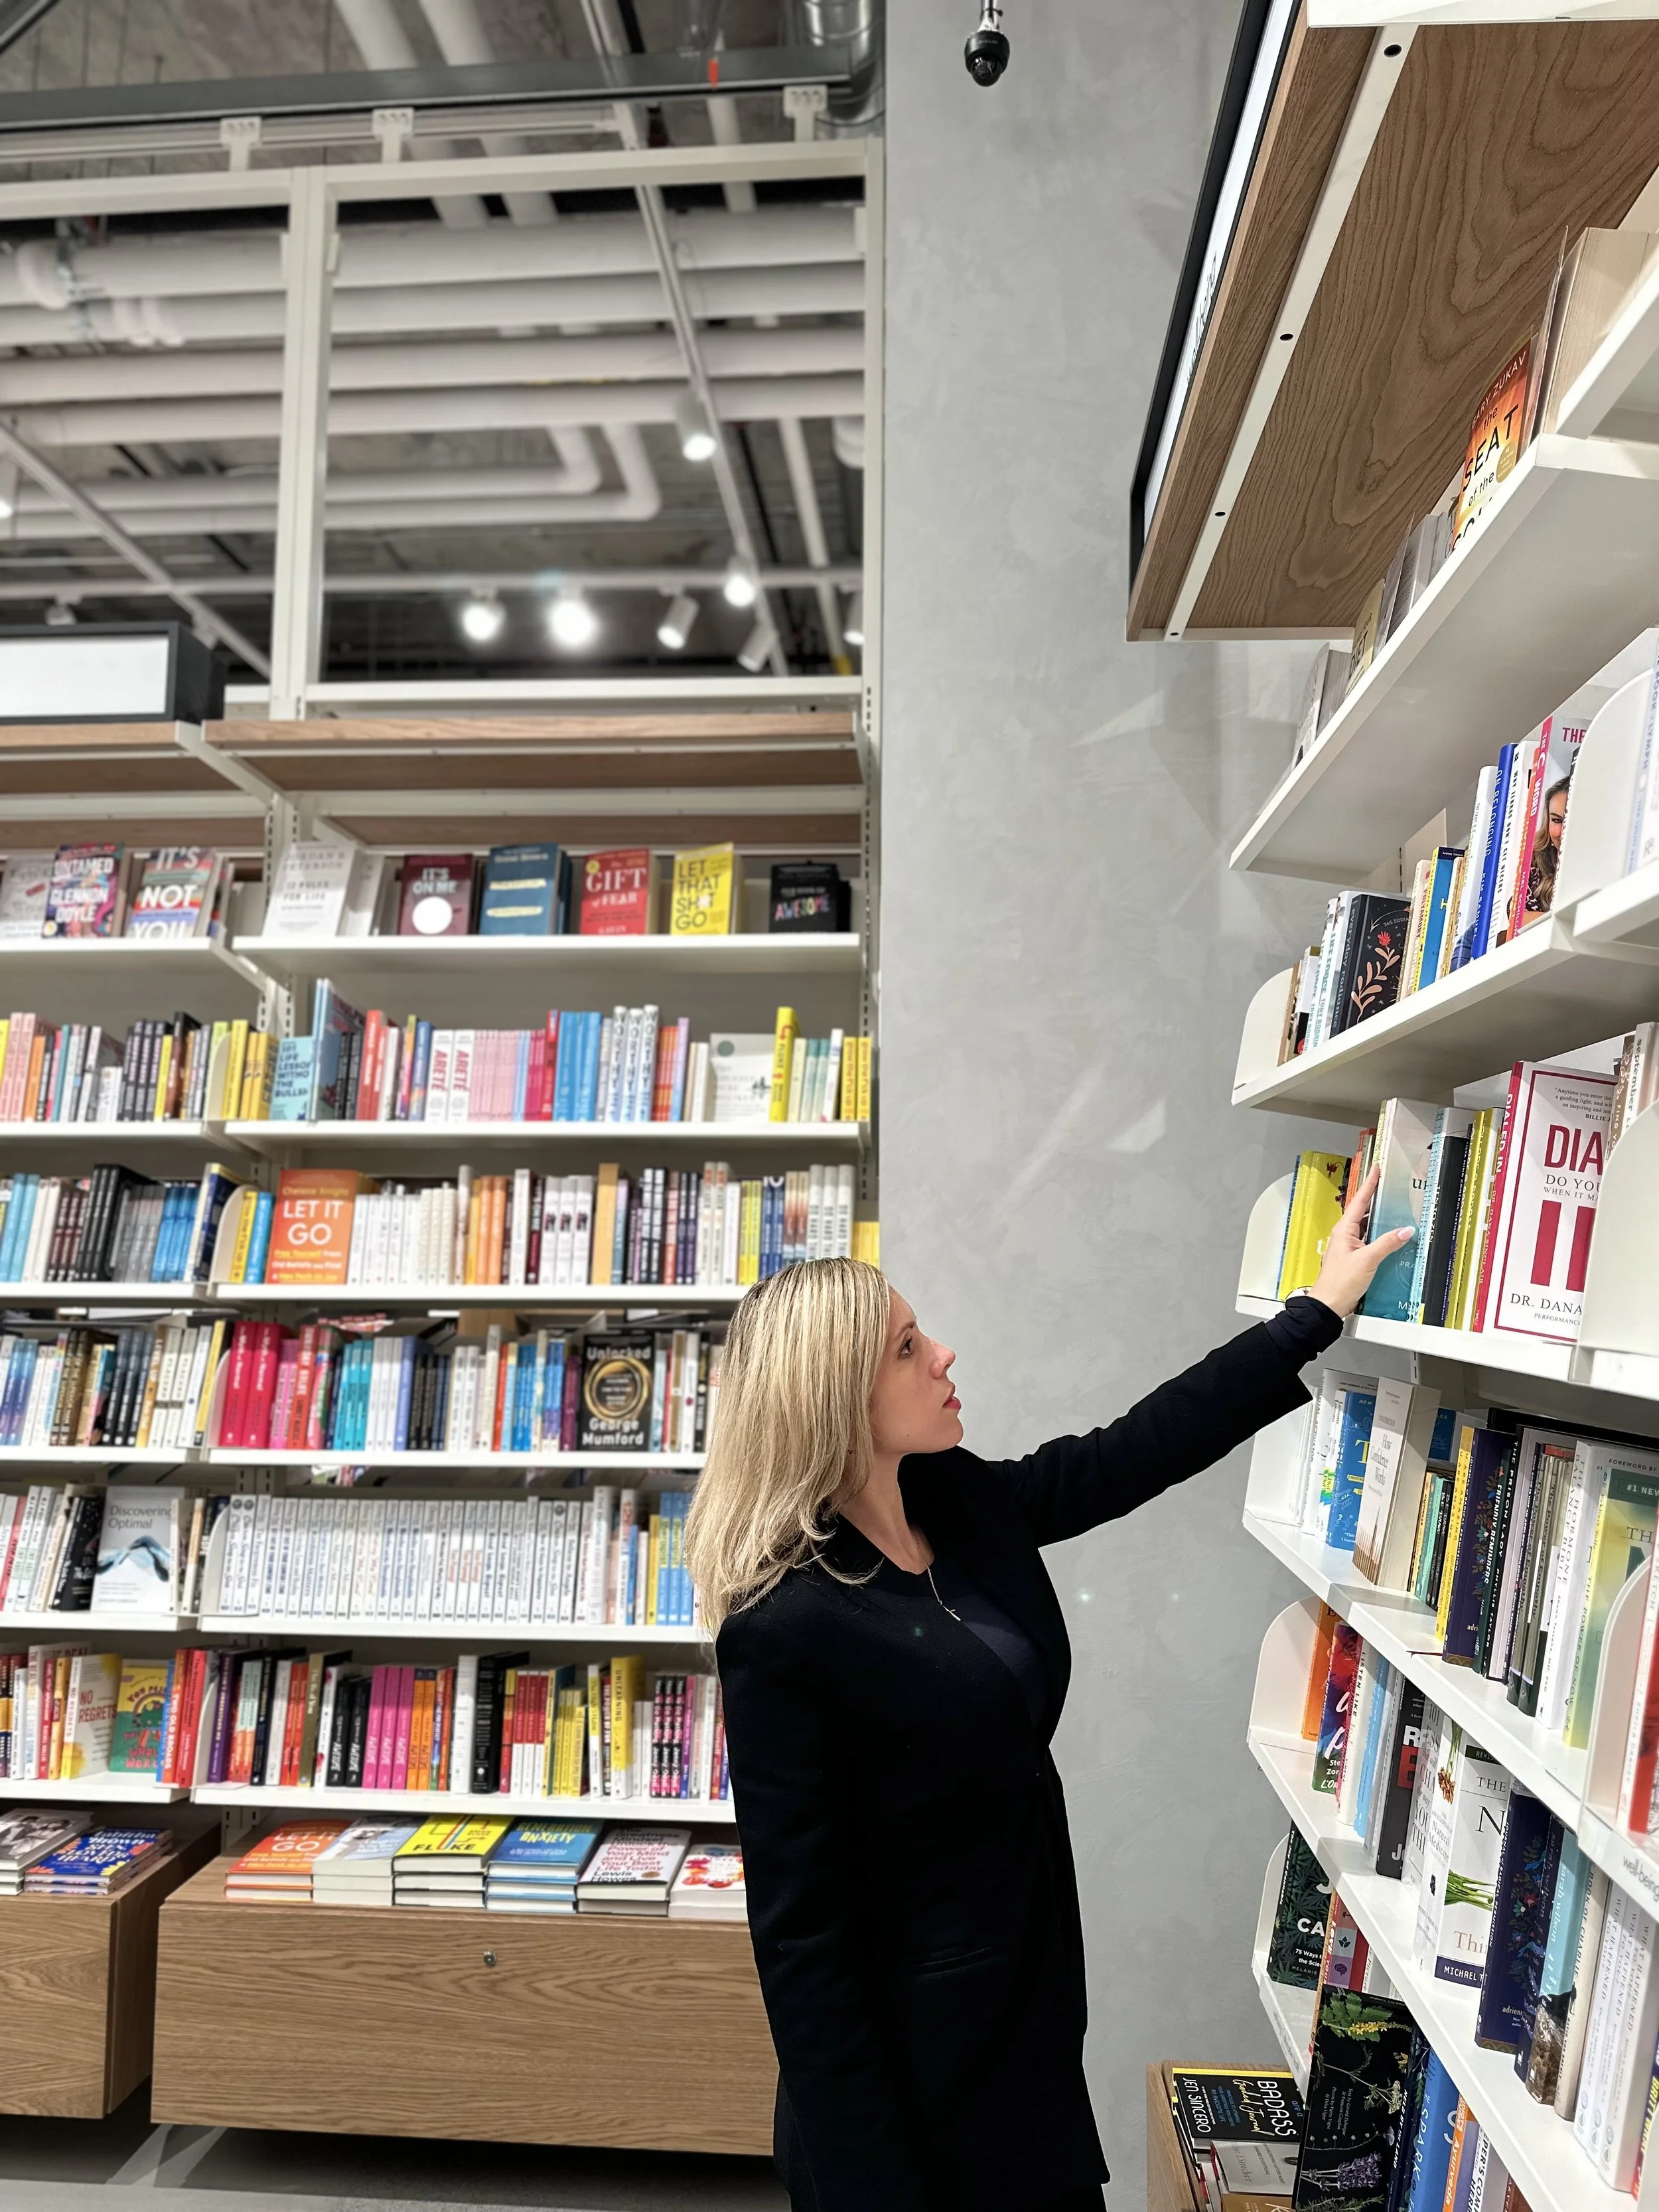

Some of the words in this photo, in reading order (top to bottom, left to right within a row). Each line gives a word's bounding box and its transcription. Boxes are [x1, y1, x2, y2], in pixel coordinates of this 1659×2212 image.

[1471, 397, 1492, 430] GARY
[1492, 351, 1526, 398] ZUKAV
[1483, 407, 1498, 430] the
[1462, 404, 1519, 493] SEAT
[1469, 488, 1479, 507] of
[1479, 471, 1494, 494] the
[1540, 731, 1548, 752] THE
[1562, 727, 1585, 744] THE
[1642, 723, 1653, 770] LYMPH
[1507, 791, 1516, 820] ZEBRAS
[1530, 777, 1543, 817] WORD
[1503, 822, 1512, 844] DON'T
[155, 847, 200, 870] IT'S
[678, 859, 707, 878] LET
[413, 881, 433, 895] ON
[435, 881, 459, 894] ME
[423, 867, 450, 881] IT'S
[585, 867, 646, 893] GIFT
[677, 873, 721, 895] THAT
[1496, 865, 1506, 894] ULCERS
[141, 885, 198, 908] NOT
[601, 892, 638, 907] FEAR
[774, 894, 830, 921] AWESOME
[675, 911, 707, 930] GO
[1473, 896, 1484, 939] SAMUEL
[1342, 907, 1356, 968] everyday
[1333, 970, 1346, 1030] radiance
[276, 1080, 293, 1088] THE
[1628, 1039, 1642, 1112] september
[1500, 1092, 1513, 1152] DIALED
[1569, 1102, 1591, 1112] inspiring
[1496, 1155, 1504, 1173] IN
[1455, 1179, 1464, 1211] CONTROL
[1544, 1187, 1571, 1197] WHEN
[1546, 1175, 1568, 1187] DO
[283, 1200, 319, 1218] LET
[324, 1200, 344, 1218] IT
[1485, 1209, 1495, 1236] DANA
[287, 1222, 332, 1245] GO
[1479, 1238, 1490, 1284] SINCLAIR
[1510, 1293, 1535, 1307] DR.
[1540, 1297, 1583, 1315] DANA
[586, 1346, 652, 1359] Unlocked
[581, 1432, 644, 1445] Mumford
[589, 1418, 640, 1432] George
[1382, 1433, 1393, 1449] How
[1370, 1446, 1389, 1469] Confidence
[1609, 1458, 1646, 1470] FOREWORD
[1374, 1467, 1386, 1486] Works
[1576, 1459, 1586, 1491] THE
[1491, 1484, 1503, 1528] FRIENDLY
[1503, 1469, 1515, 1519] PRISON
[108, 1518, 153, 1534] Optimal
[1447, 1487, 1459, 1539] AMAZING
[1453, 1489, 1464, 1542] AMAZING
[1498, 1524, 1507, 1558] LADY
[1541, 1512, 1551, 1547] Power
[1562, 1499, 1580, 1586] HORMONE
[1454, 1528, 1464, 1572] PERMISSION
[1482, 1529, 1496, 1585] REMINDERS
[1491, 1568, 1500, 1608] PHYLLIS
[1532, 1565, 1544, 1620] Empathy
[1577, 1606, 1588, 1651] POWER
[1354, 1651, 1366, 1690] LISTEN
[80, 1690, 93, 1705] NO
[1568, 1676, 1579, 1707] NOW
[78, 1704, 117, 1724] REGRETS
[1428, 1702, 1441, 1721] 101
[163, 1736, 176, 1769] BROADS
[1477, 1776, 1507, 1793] THE
[271, 1840, 321, 1852] GO
[273, 1832, 316, 1841] LET
[519, 1832, 576, 1844] ANXIETY
[1427, 1831, 1450, 1861] Medicine
[1431, 1819, 1451, 1848] Natural
[1500, 1820, 1510, 1858] JOURNAL
[1279, 1871, 1288, 1905] Cannabis
[1557, 1863, 1567, 1899] sarah
[1585, 1871, 1595, 1905] BOOK
[1623, 1855, 1659, 1902] well-being
[1488, 1900, 1498, 1948] PERMISSION
[1551, 1901, 1563, 1943] wilson
[1613, 1898, 1622, 1931] WHAT
[1627, 1913, 1638, 1946] WHAT
[1303, 1950, 1319, 1959] Ways
[1573, 1926, 1586, 1978] CHARLIE
[1638, 1925, 1650, 1961] WHAT
[1292, 1965, 1317, 1975] MELANIE
[1443, 1964, 1477, 1980] MICHAEL
[1601, 1936, 1615, 2000] HAPPENED
[1615, 1951, 1632, 2016] HAPPENED
[1627, 1964, 1643, 2031] HAPPENED
[1183, 2077, 1200, 2093] JEN
[1187, 2094, 1212, 2133] SINCERO
[1257, 2081, 1297, 2136] BADASS
[1291, 2100, 1301, 2111] are
[1413, 2108, 1429, 2182] SPARK
[1445, 2136, 1461, 2205] Ayurveda
